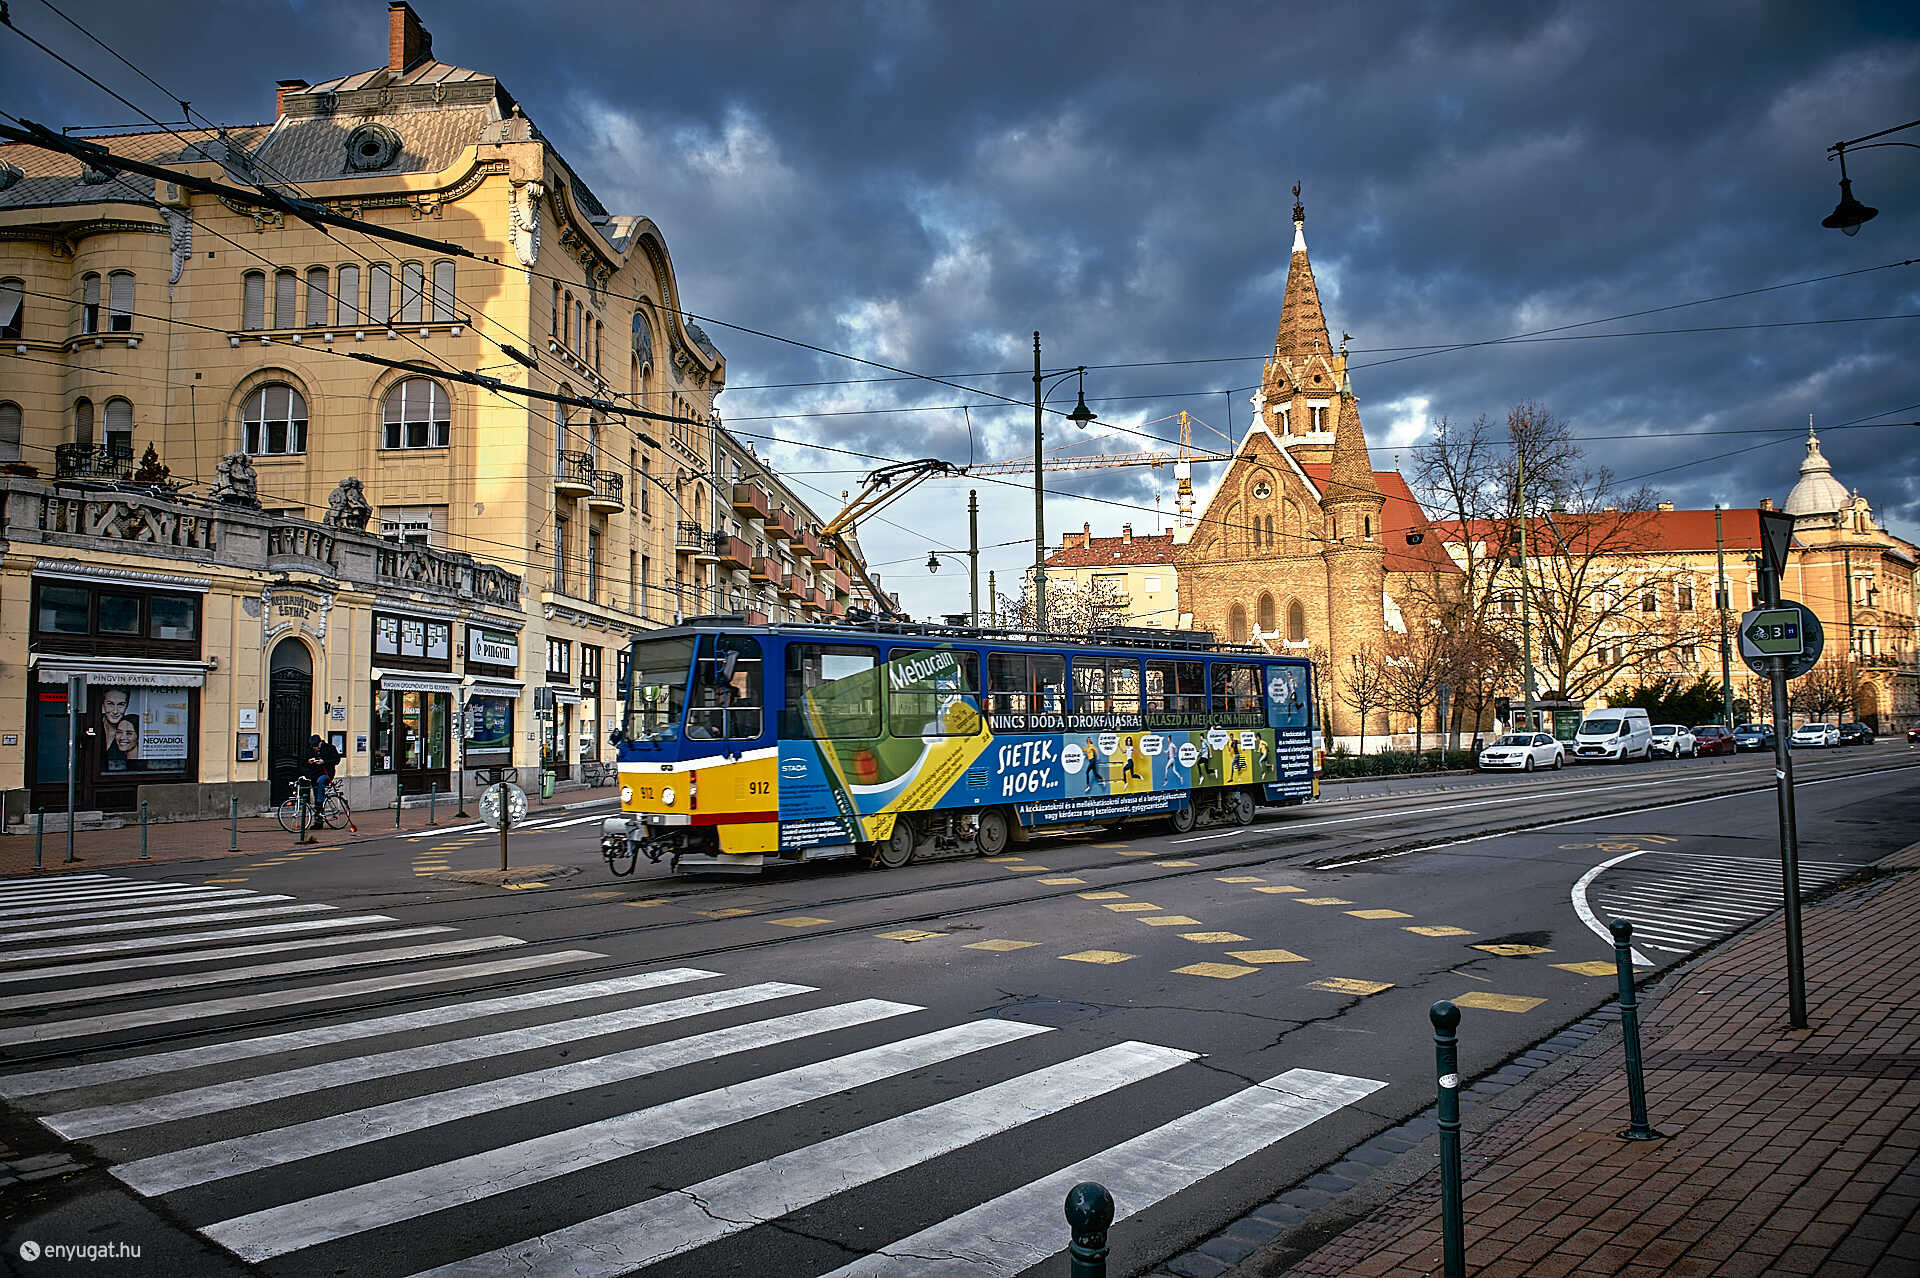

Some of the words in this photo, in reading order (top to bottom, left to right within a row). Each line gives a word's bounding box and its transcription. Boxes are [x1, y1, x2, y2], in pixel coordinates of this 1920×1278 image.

[1773, 627, 1781, 637] 3
[484, 644, 510, 659] PINGVIN
[889, 652, 954, 691] Mebucain
[990, 715, 1025, 729] NINCS
[1056, 715, 1065, 728] A
[1183, 715, 1190, 725] A
[781, 764, 808, 772] STADA
[641, 786, 654, 799] 912
[749, 781, 770, 794] 912
